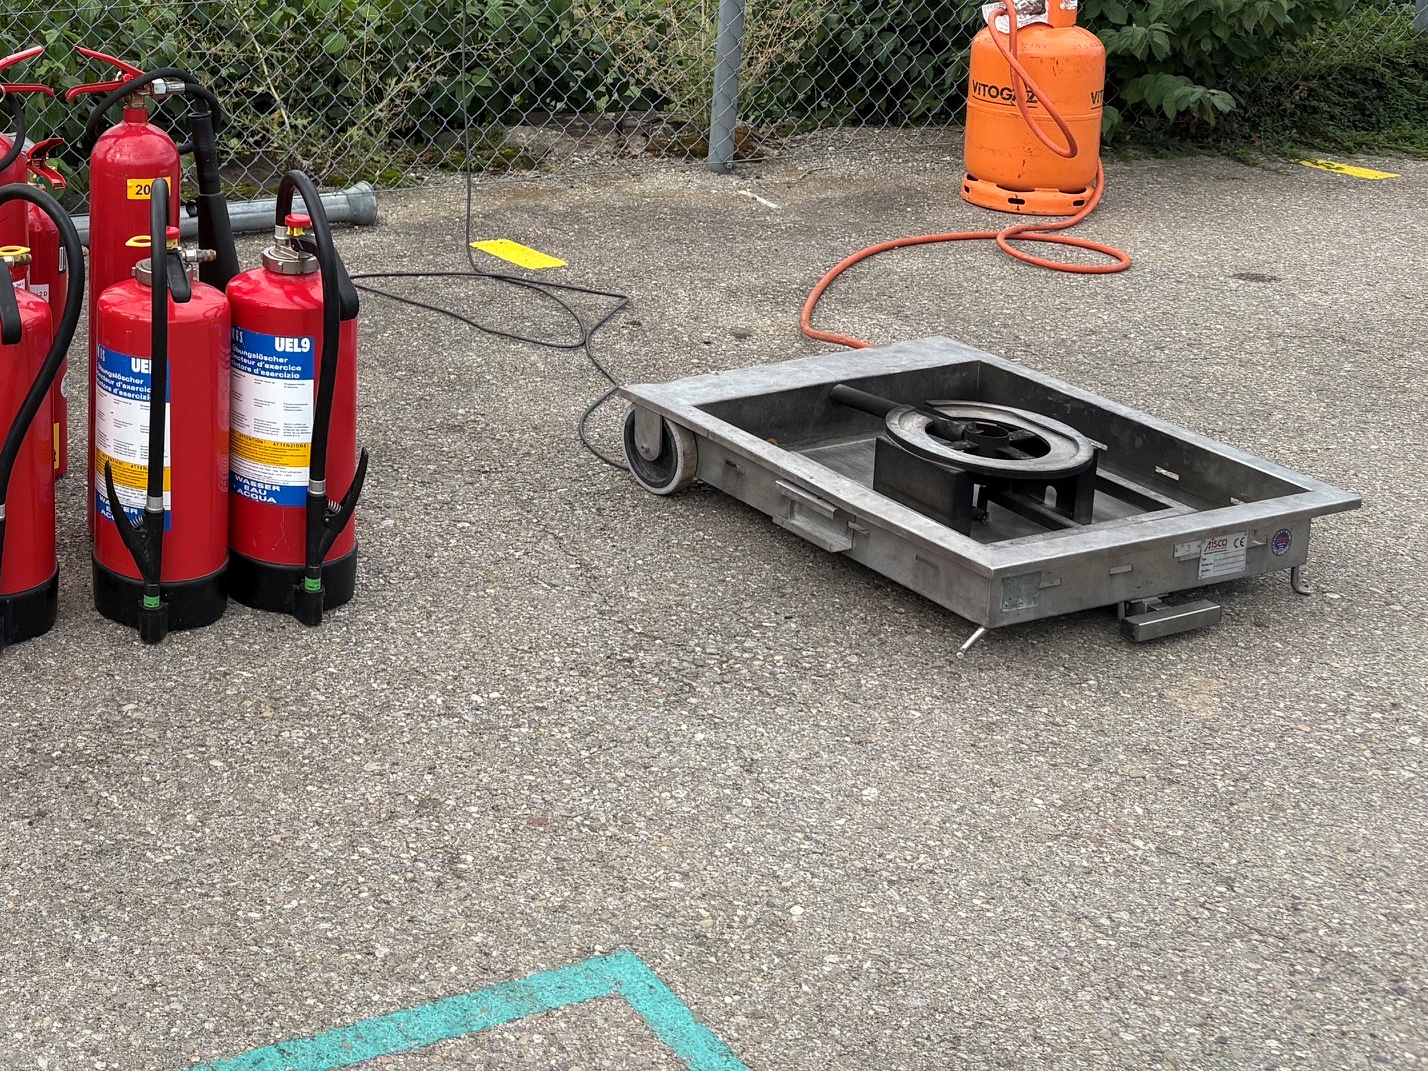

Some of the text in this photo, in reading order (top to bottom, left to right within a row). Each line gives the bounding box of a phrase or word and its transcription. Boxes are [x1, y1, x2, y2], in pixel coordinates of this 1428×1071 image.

[274, 337, 311, 353] UEL9
[253, 368, 300, 379] d'esercizio
[257, 361, 302, 372] d'exercice
[234, 474, 280, 492] WASSER
[243, 484, 267, 496] EAU
[237, 488, 277, 504] ACQUA
